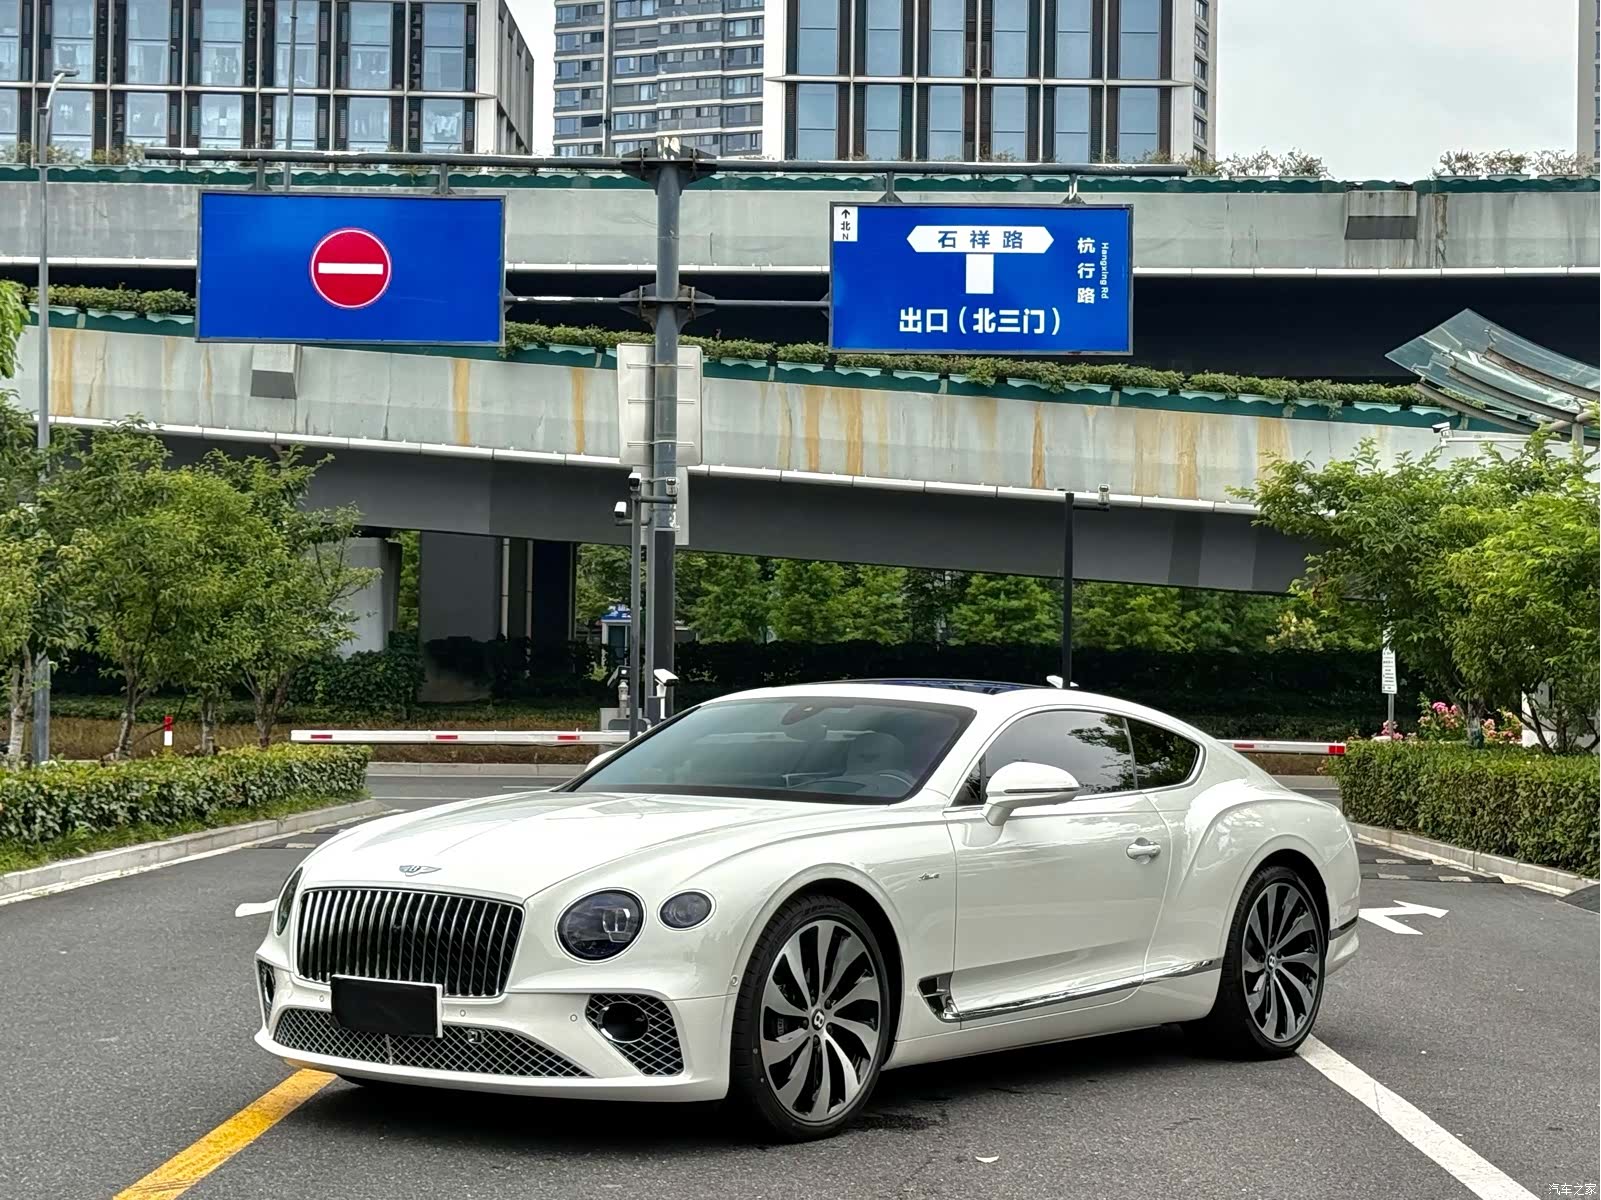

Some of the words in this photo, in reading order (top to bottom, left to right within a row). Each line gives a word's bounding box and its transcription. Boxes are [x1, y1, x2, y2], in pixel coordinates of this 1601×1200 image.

[840, 221, 851, 231] 北
[937, 230, 1023, 249] 石祥路
[1077, 237, 1096, 304] 杭行路
[1101, 287, 1110, 299] Rd
